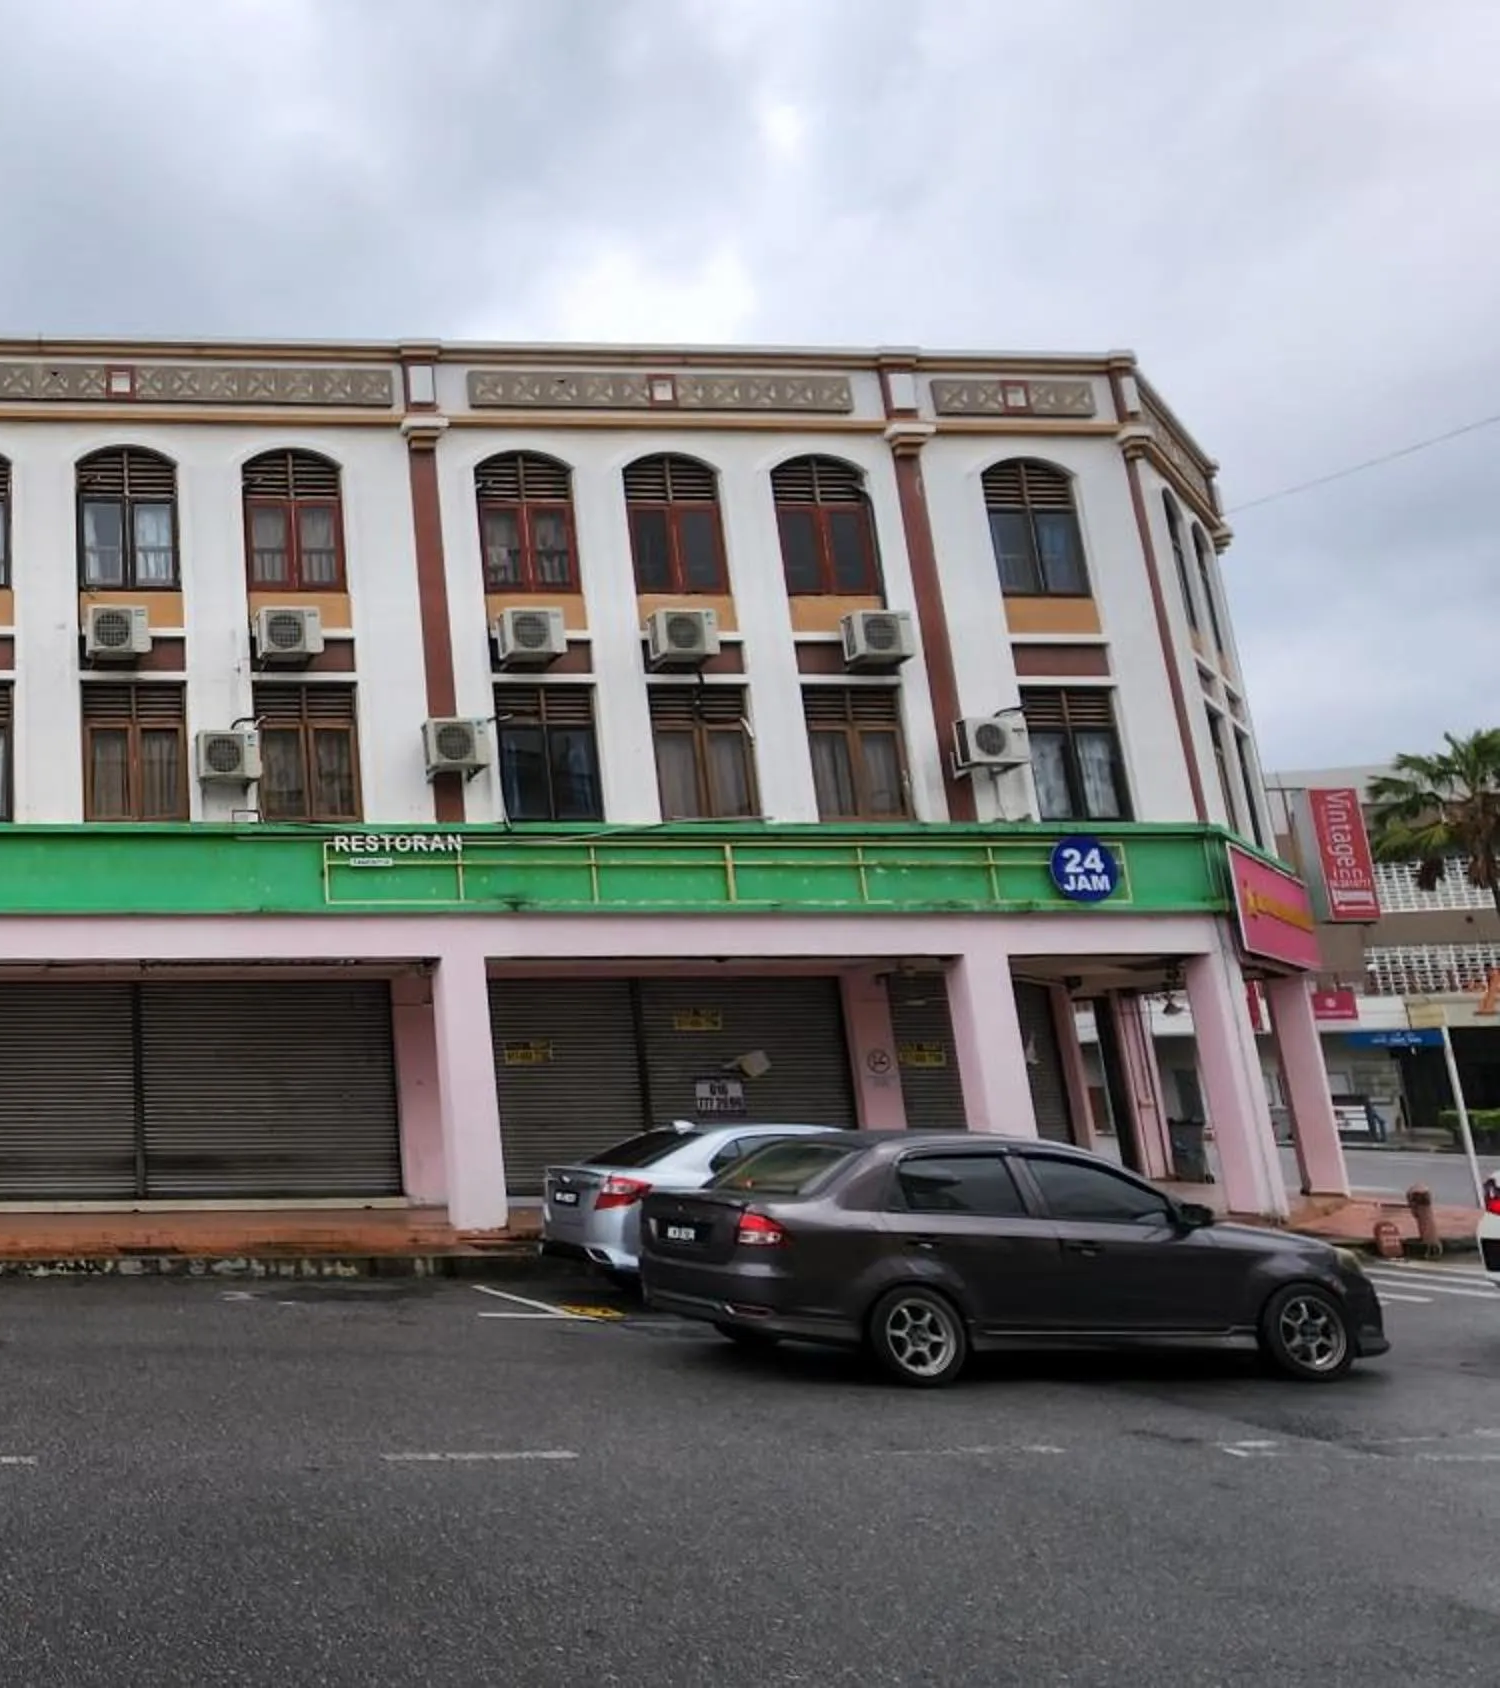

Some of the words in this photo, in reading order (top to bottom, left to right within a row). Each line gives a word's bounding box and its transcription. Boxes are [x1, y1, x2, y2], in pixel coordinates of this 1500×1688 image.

[1324, 789, 1357, 867] Vintage
[333, 834, 462, 853] RESTORAN
[1061, 847, 1105, 873] 24
[1063, 873, 1111, 892] JAM
